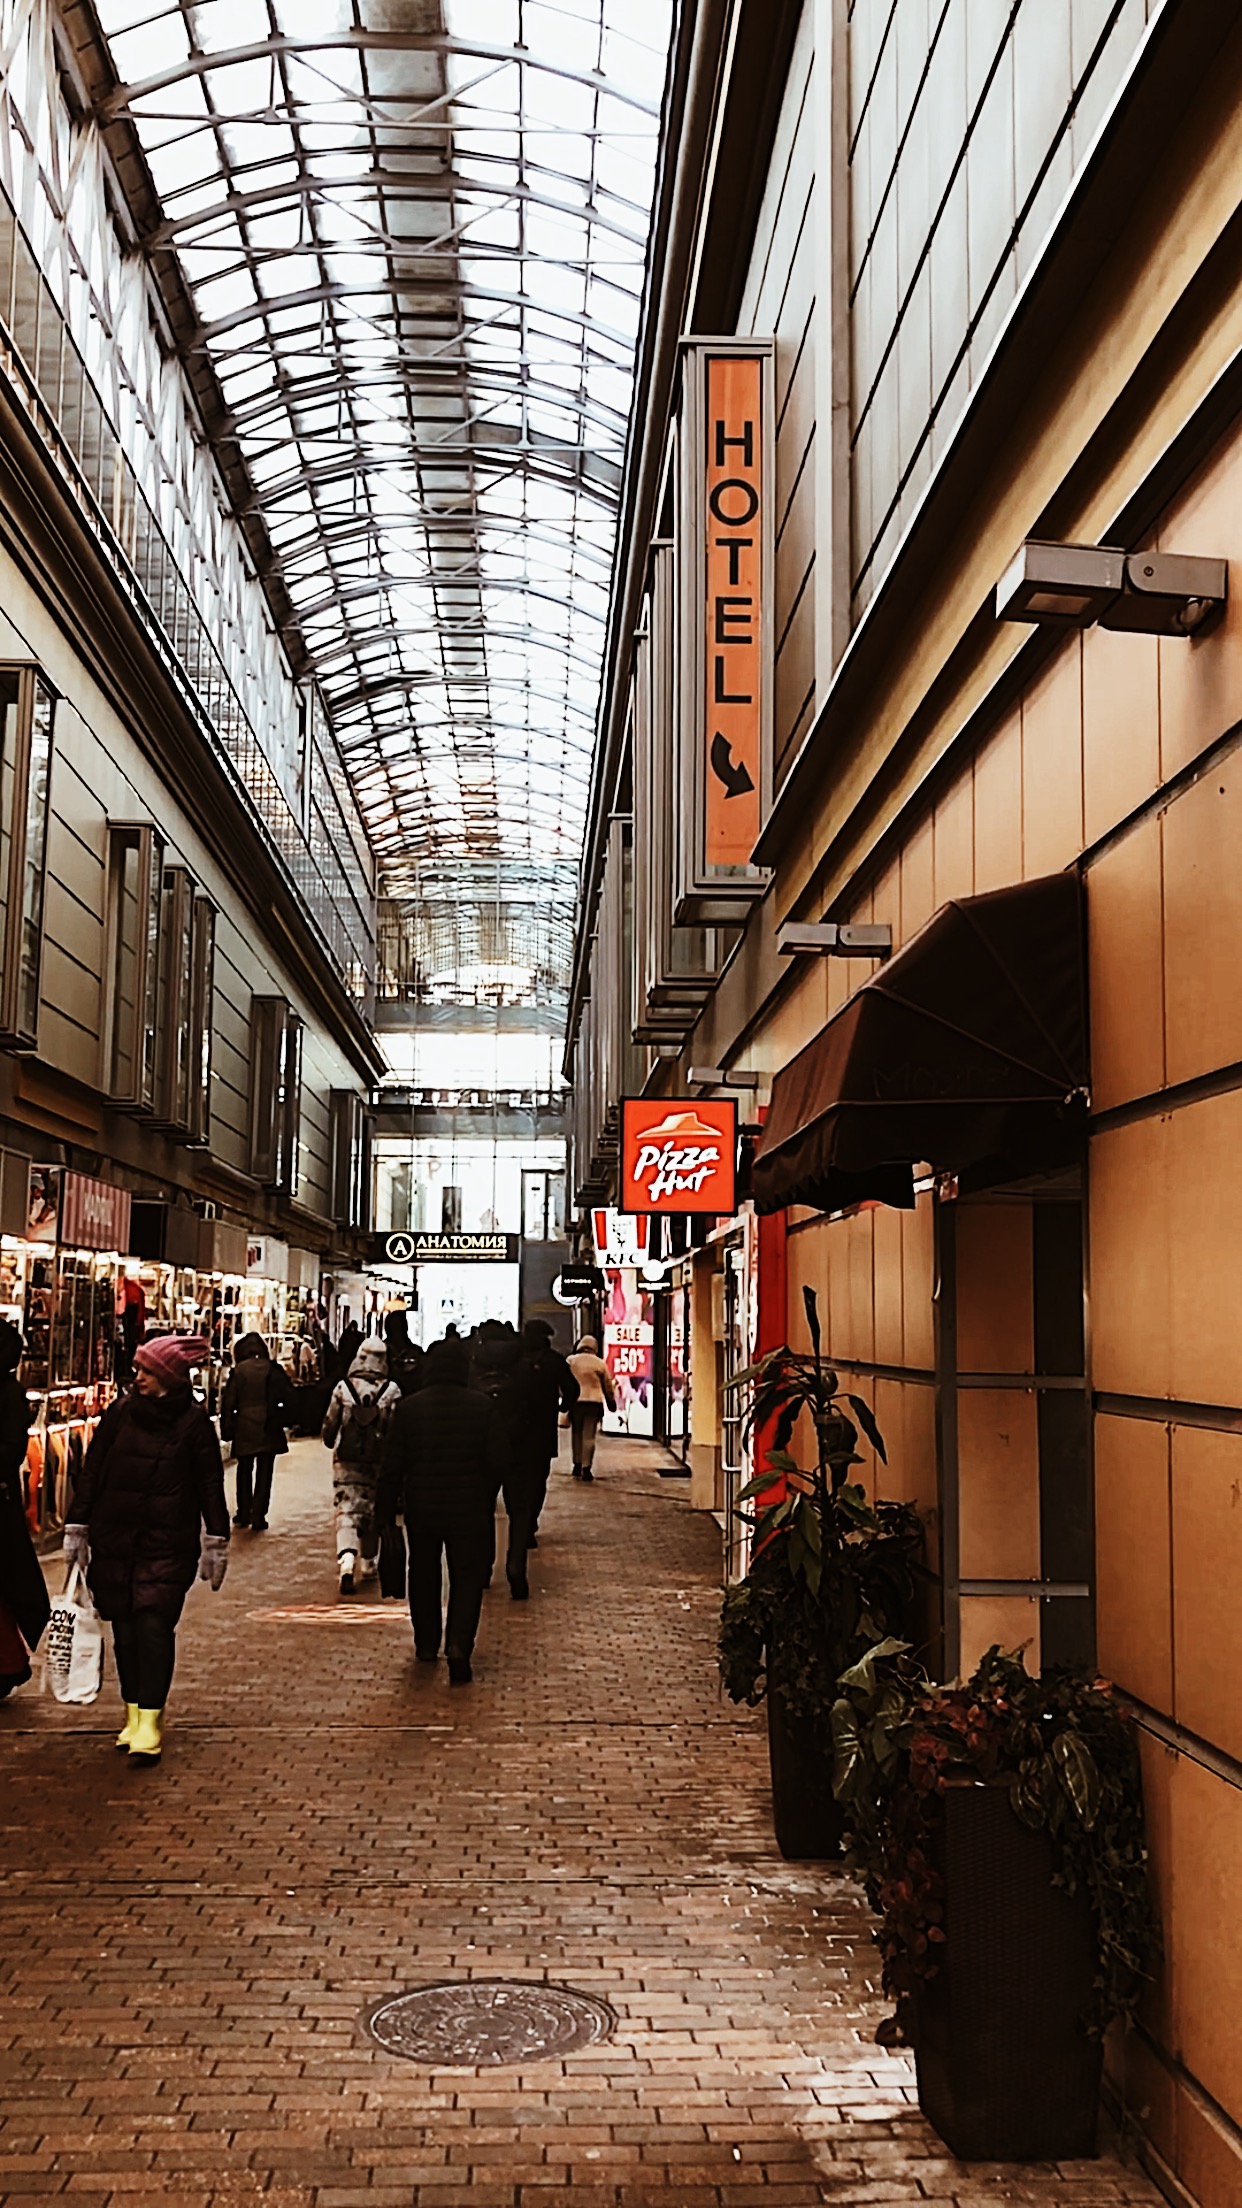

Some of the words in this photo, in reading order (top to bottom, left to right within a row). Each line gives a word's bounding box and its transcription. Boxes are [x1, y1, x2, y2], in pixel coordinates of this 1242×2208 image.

[709, 420, 759, 704] HOTEL
[633, 1140, 720, 1181] Pizza
[647, 1165, 717, 1202] Hut
[416, 1235, 507, 1249] АНАТОМИЯ
[616, 1327, 640, 1342] SALE
